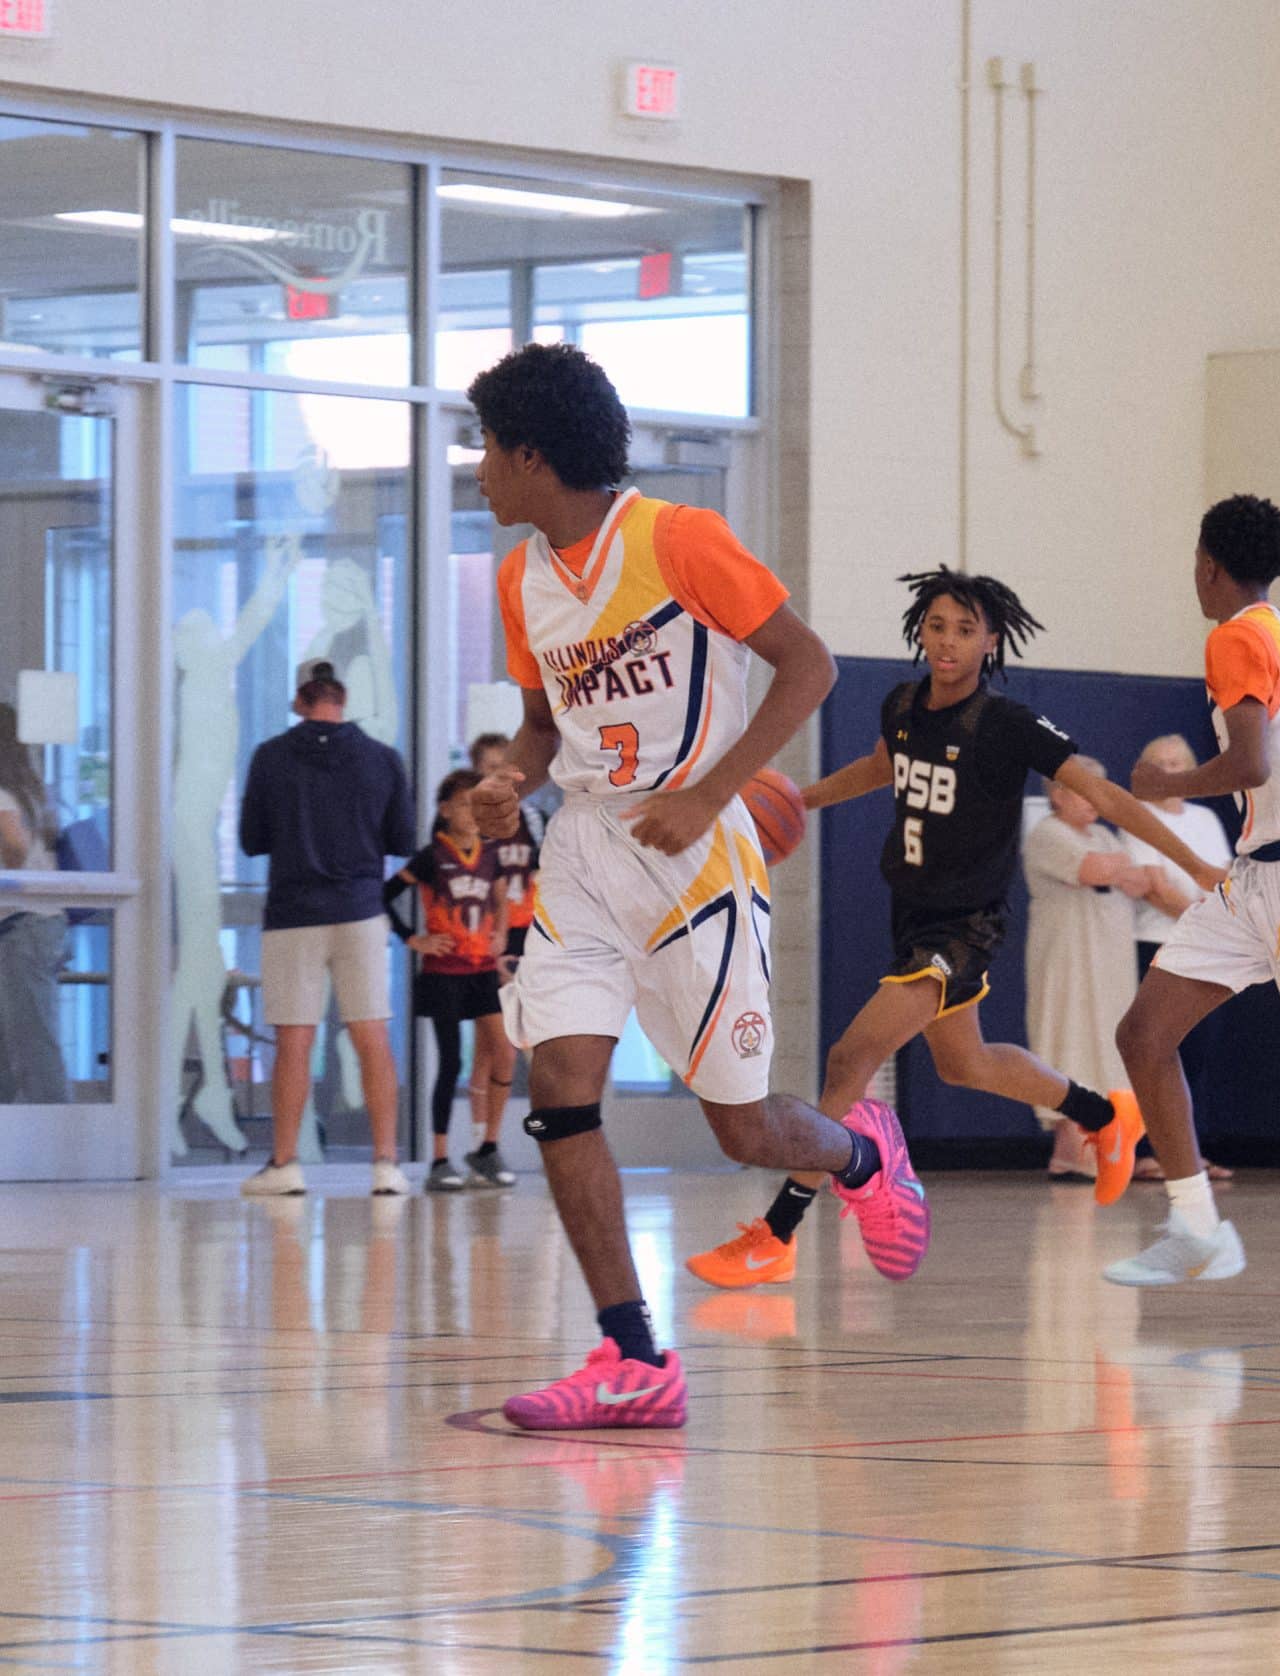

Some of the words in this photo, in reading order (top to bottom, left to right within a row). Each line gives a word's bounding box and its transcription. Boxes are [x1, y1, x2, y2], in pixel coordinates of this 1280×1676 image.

[636, 66, 677, 112] EXIT
[543, 637, 621, 672] ILLINOIS
[555, 651, 674, 712] IMPACT
[598, 722, 640, 787] 3
[894, 752, 957, 815] PSB
[904, 817, 924, 867] 6
